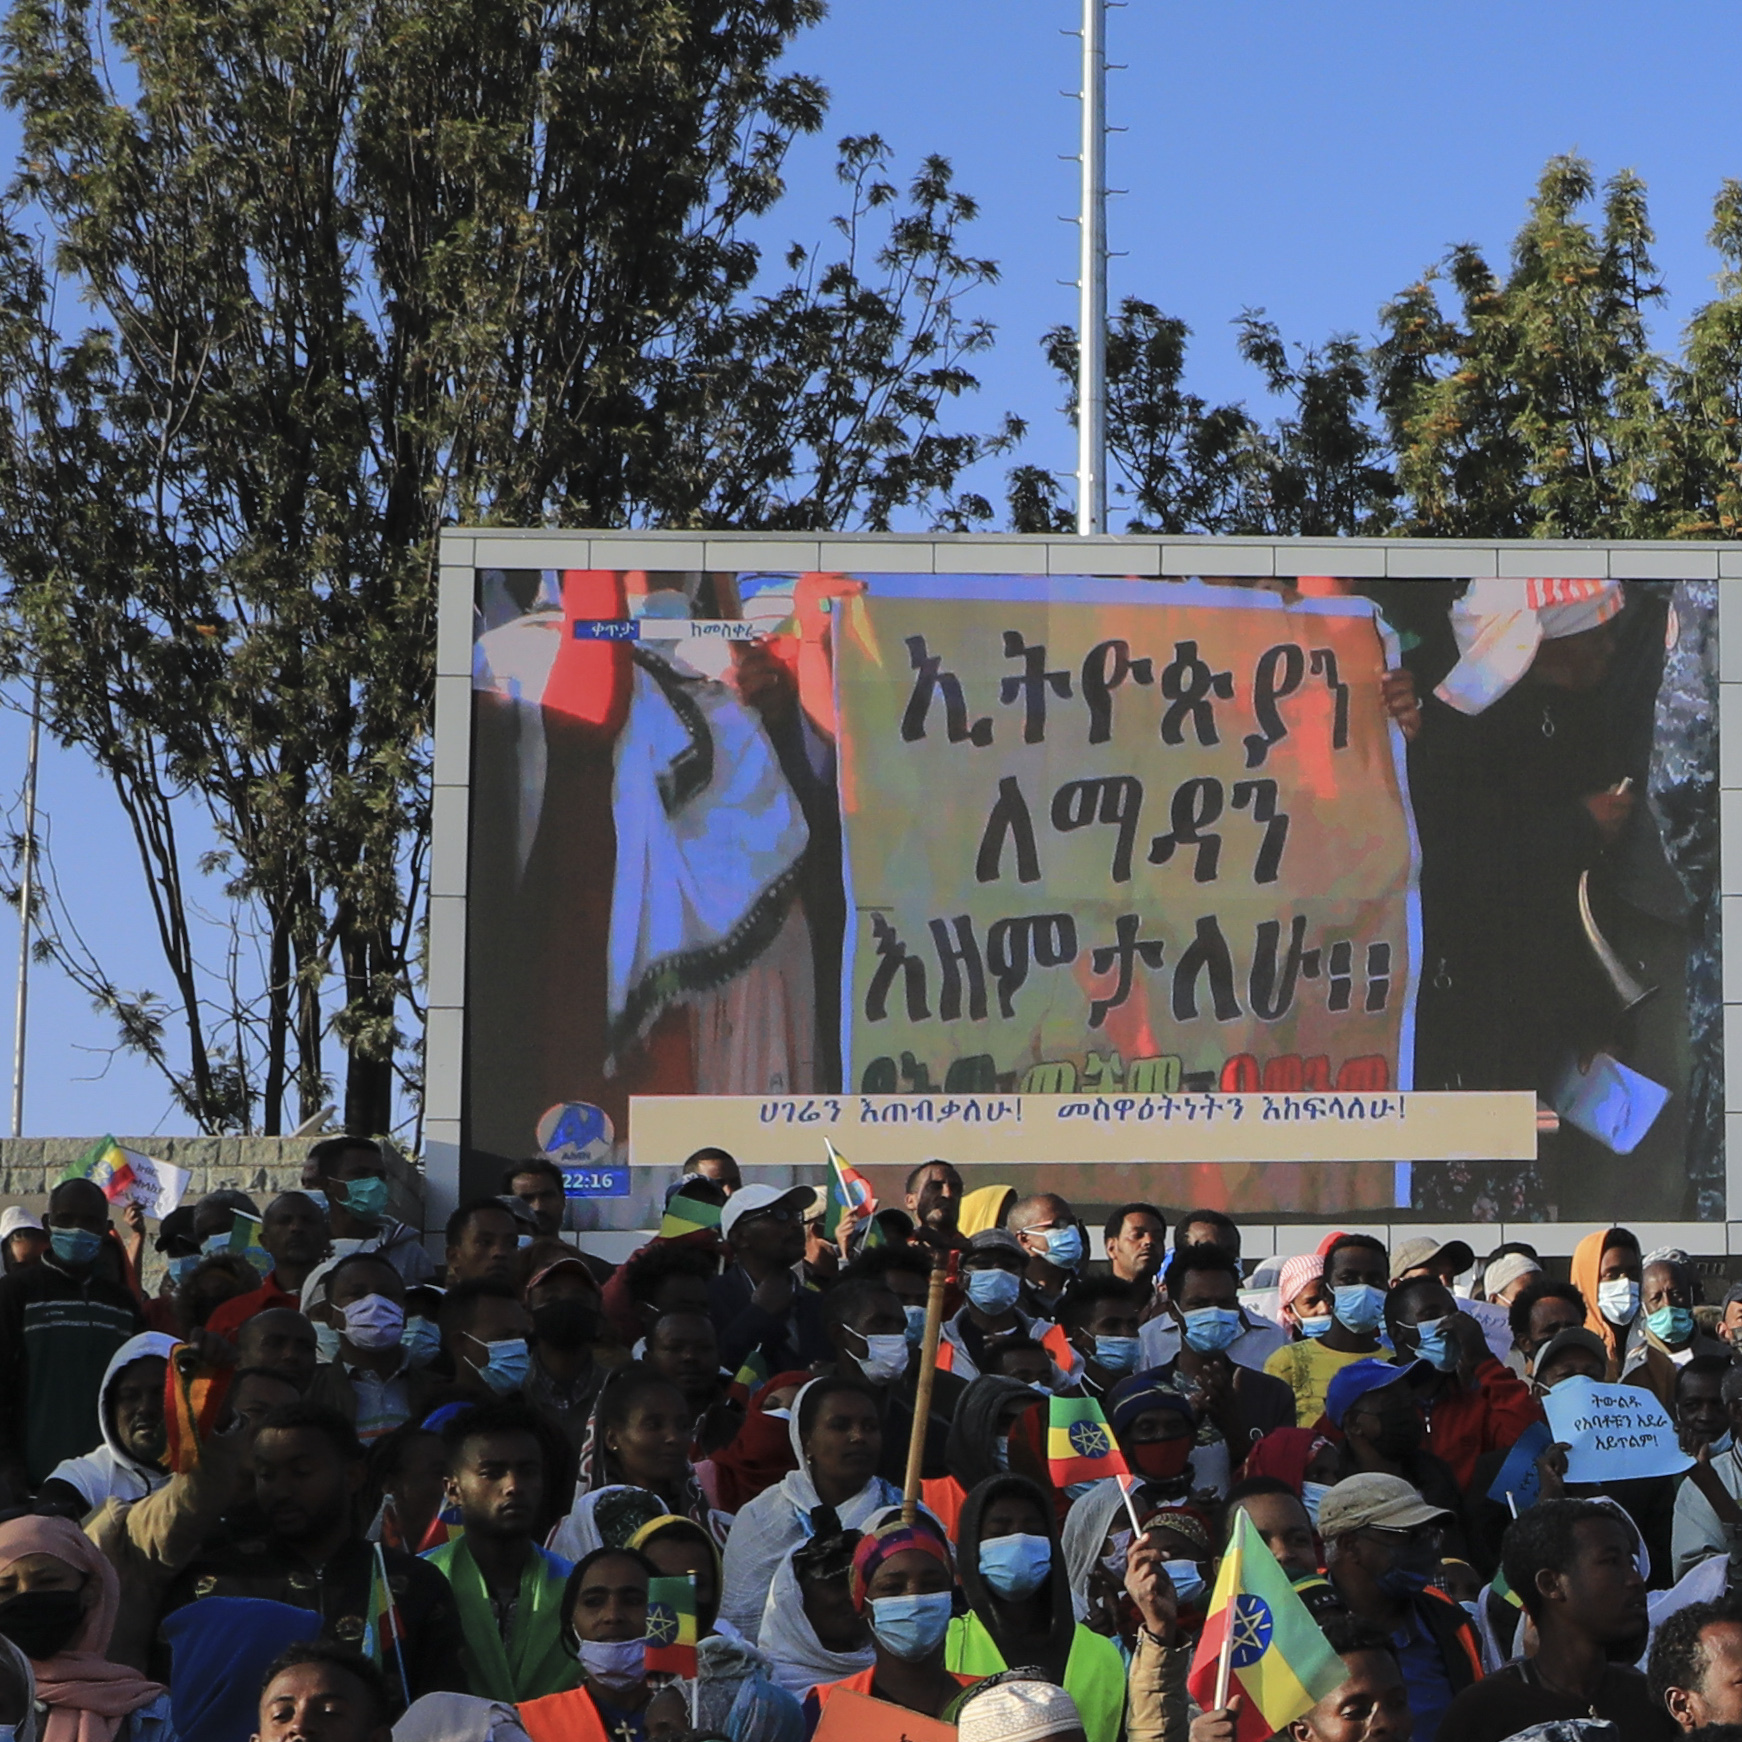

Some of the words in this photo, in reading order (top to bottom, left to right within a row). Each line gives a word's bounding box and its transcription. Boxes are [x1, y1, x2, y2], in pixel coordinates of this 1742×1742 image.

[591, 622, 635, 638] ቀጥታ
[901, 629, 1350, 769] ኢትዮጵያን
[975, 774, 1289, 886] ለማዳን
[760, 1098, 842, 1123] ሀገሬን
[860, 1097, 1022, 1123] እጠብቃለሁ!
[1057, 1093, 1245, 1121] መስዋዕትነትን
[1262, 1095, 1406, 1120] እከፍላለሁ!
